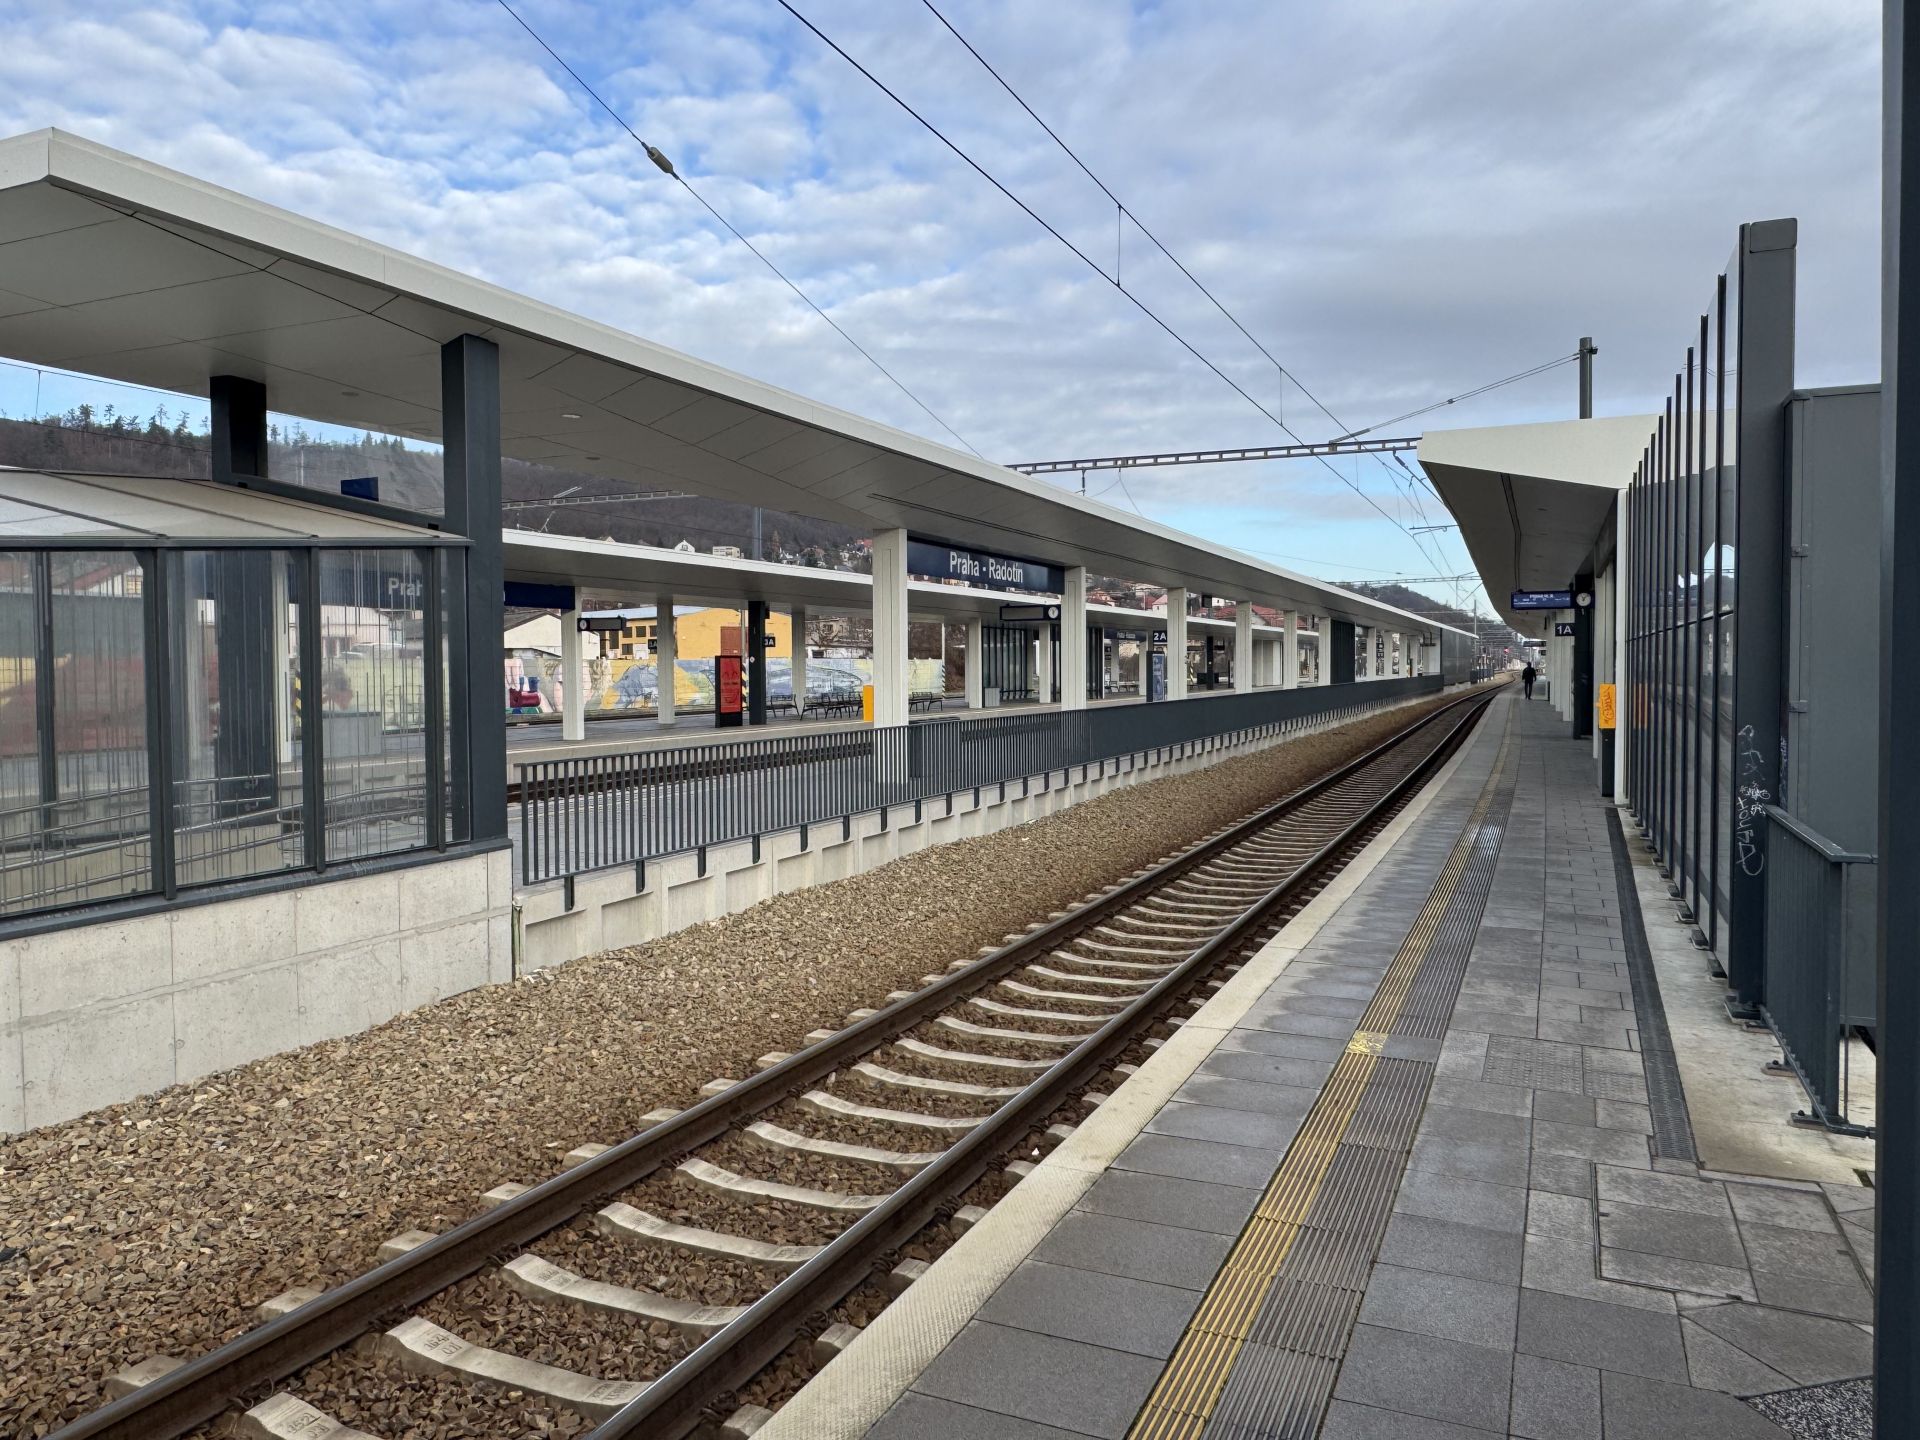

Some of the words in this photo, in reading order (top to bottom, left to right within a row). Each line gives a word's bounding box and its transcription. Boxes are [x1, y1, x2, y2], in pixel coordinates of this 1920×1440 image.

[949, 551, 980, 577] Praha
[1556, 625, 1572, 635] 1A
[1153, 632, 1167, 640] 2A
